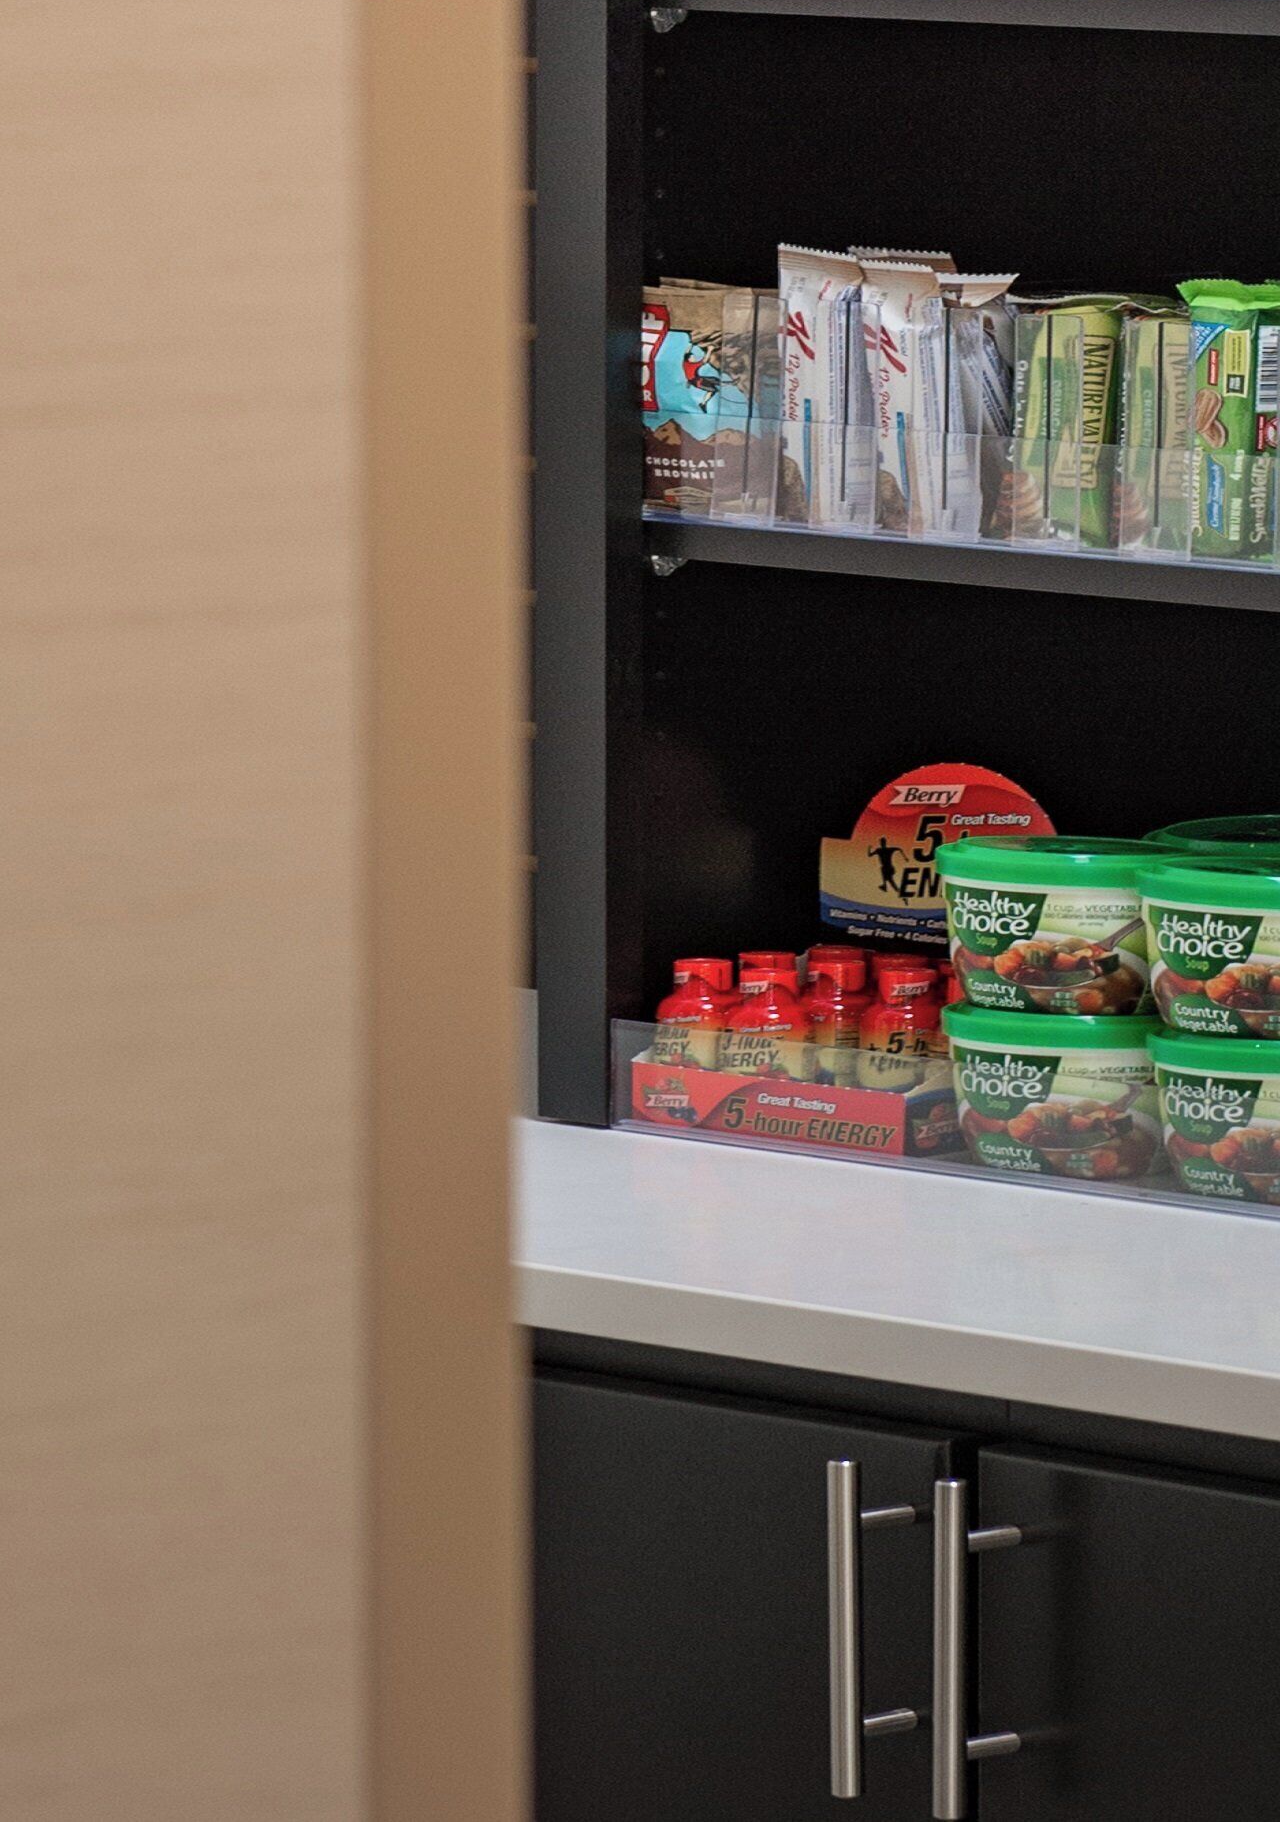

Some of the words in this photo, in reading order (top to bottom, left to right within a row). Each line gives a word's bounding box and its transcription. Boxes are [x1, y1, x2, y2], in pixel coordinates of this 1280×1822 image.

[1080, 342, 1110, 414] NATURE
[646, 456, 725, 469] CHOCOLATE
[903, 787, 959, 807] Berry
[951, 814, 984, 826] Great
[987, 813, 1031, 827] Tasting
[954, 891, 1036, 919] Healthy
[952, 907, 1030, 935] Choice
[1161, 913, 1252, 941] Healthy
[1157, 932, 1243, 959] Choice
[1186, 957, 1209, 972] Soup
[1174, 1003, 1229, 1023] Country
[1177, 1016, 1238, 1034] Vegetable
[966, 1054, 1050, 1081] Healthy
[961, 1070, 1043, 1099] Choice
[1168, 1078, 1252, 1106] Healthy
[654, 1096, 685, 1107] Berry
[758, 1093, 789, 1106] Great
[793, 1097, 836, 1113] Tasting
[1165, 1092, 1244, 1122] Choice
[723, 1097, 806, 1139] 5-hour
[807, 1118, 896, 1149] ENERGY
[978, 1141, 1033, 1160] Country
[1184, 1165, 1234, 1185] Country
